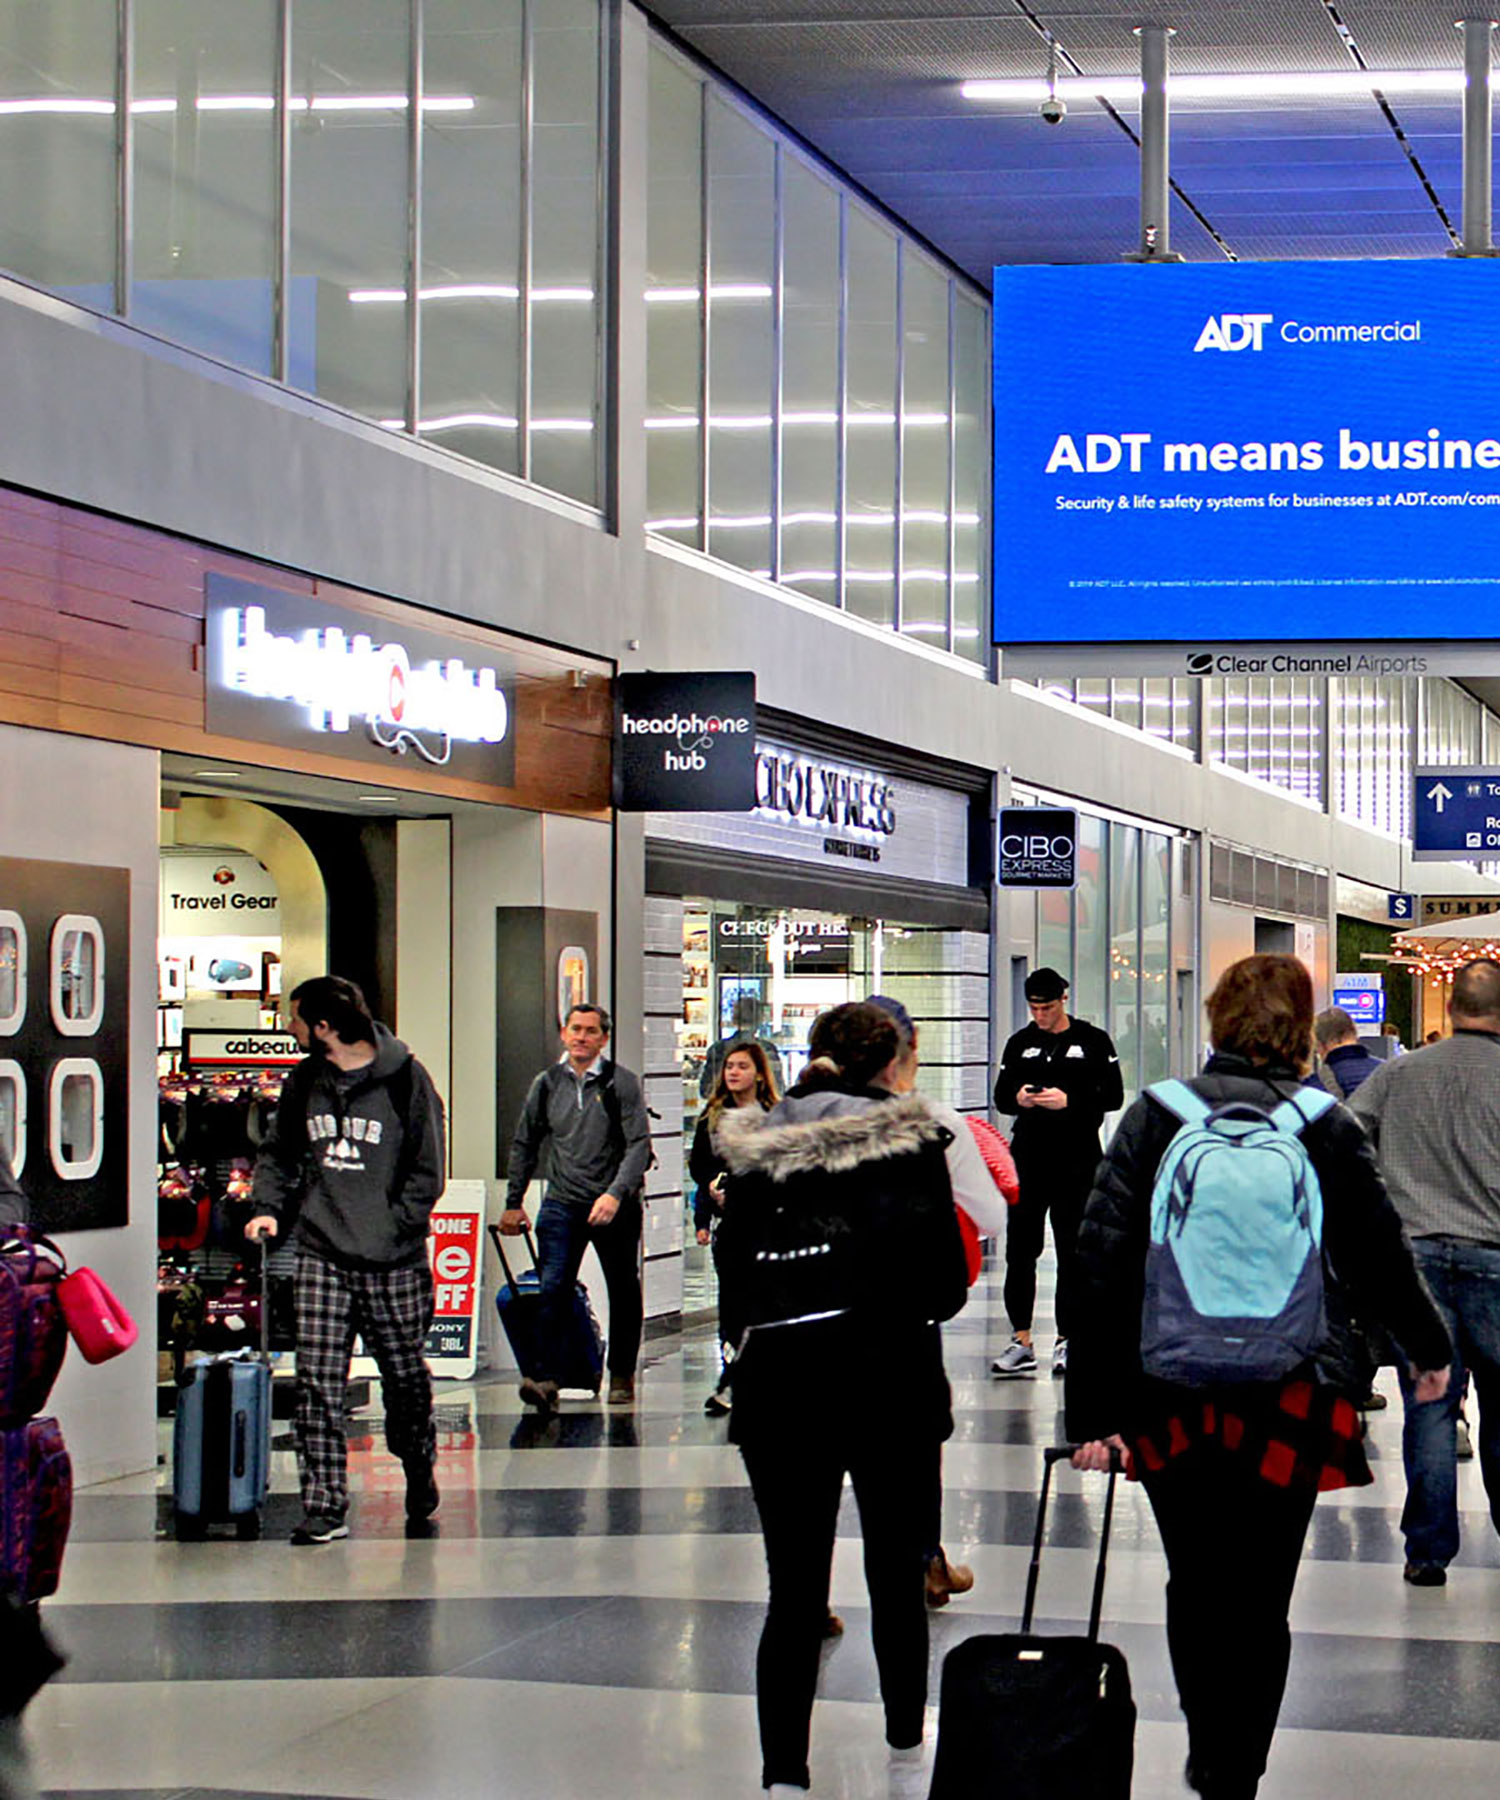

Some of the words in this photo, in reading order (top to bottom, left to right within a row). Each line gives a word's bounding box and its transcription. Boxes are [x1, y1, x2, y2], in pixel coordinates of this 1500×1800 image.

[1193, 313, 1273, 352] ADT
[1280, 320, 1420, 343] Commercial
[1045, 433, 1151, 474] ADT
[1164, 442, 1324, 471] means
[1056, 496, 1113, 513] Security
[1118, 496, 1130, 509] &
[1133, 495, 1156, 509] life
[1159, 495, 1203, 512] safety
[1206, 496, 1264, 512] systems
[1268, 494, 1289, 508] for
[1293, 491, 1373, 507] businesses
[1376, 493, 1391, 506] at
[1217, 655, 1267, 673] Clear
[1272, 655, 1351, 673] Channel
[1356, 655, 1428, 676] Airports
[622, 713, 749, 739] headphone
[665, 751, 706, 771] hub
[806, 766, 895, 836] EXPRESS
[1001, 835, 1073, 859] CIBO
[1002, 859, 1072, 872] EXPRESS
[171, 894, 226, 909] Travel
[231, 893, 278, 909] Gear
[225, 1038, 299, 1054] cabeau
[431, 1218, 471, 1234] ONE
